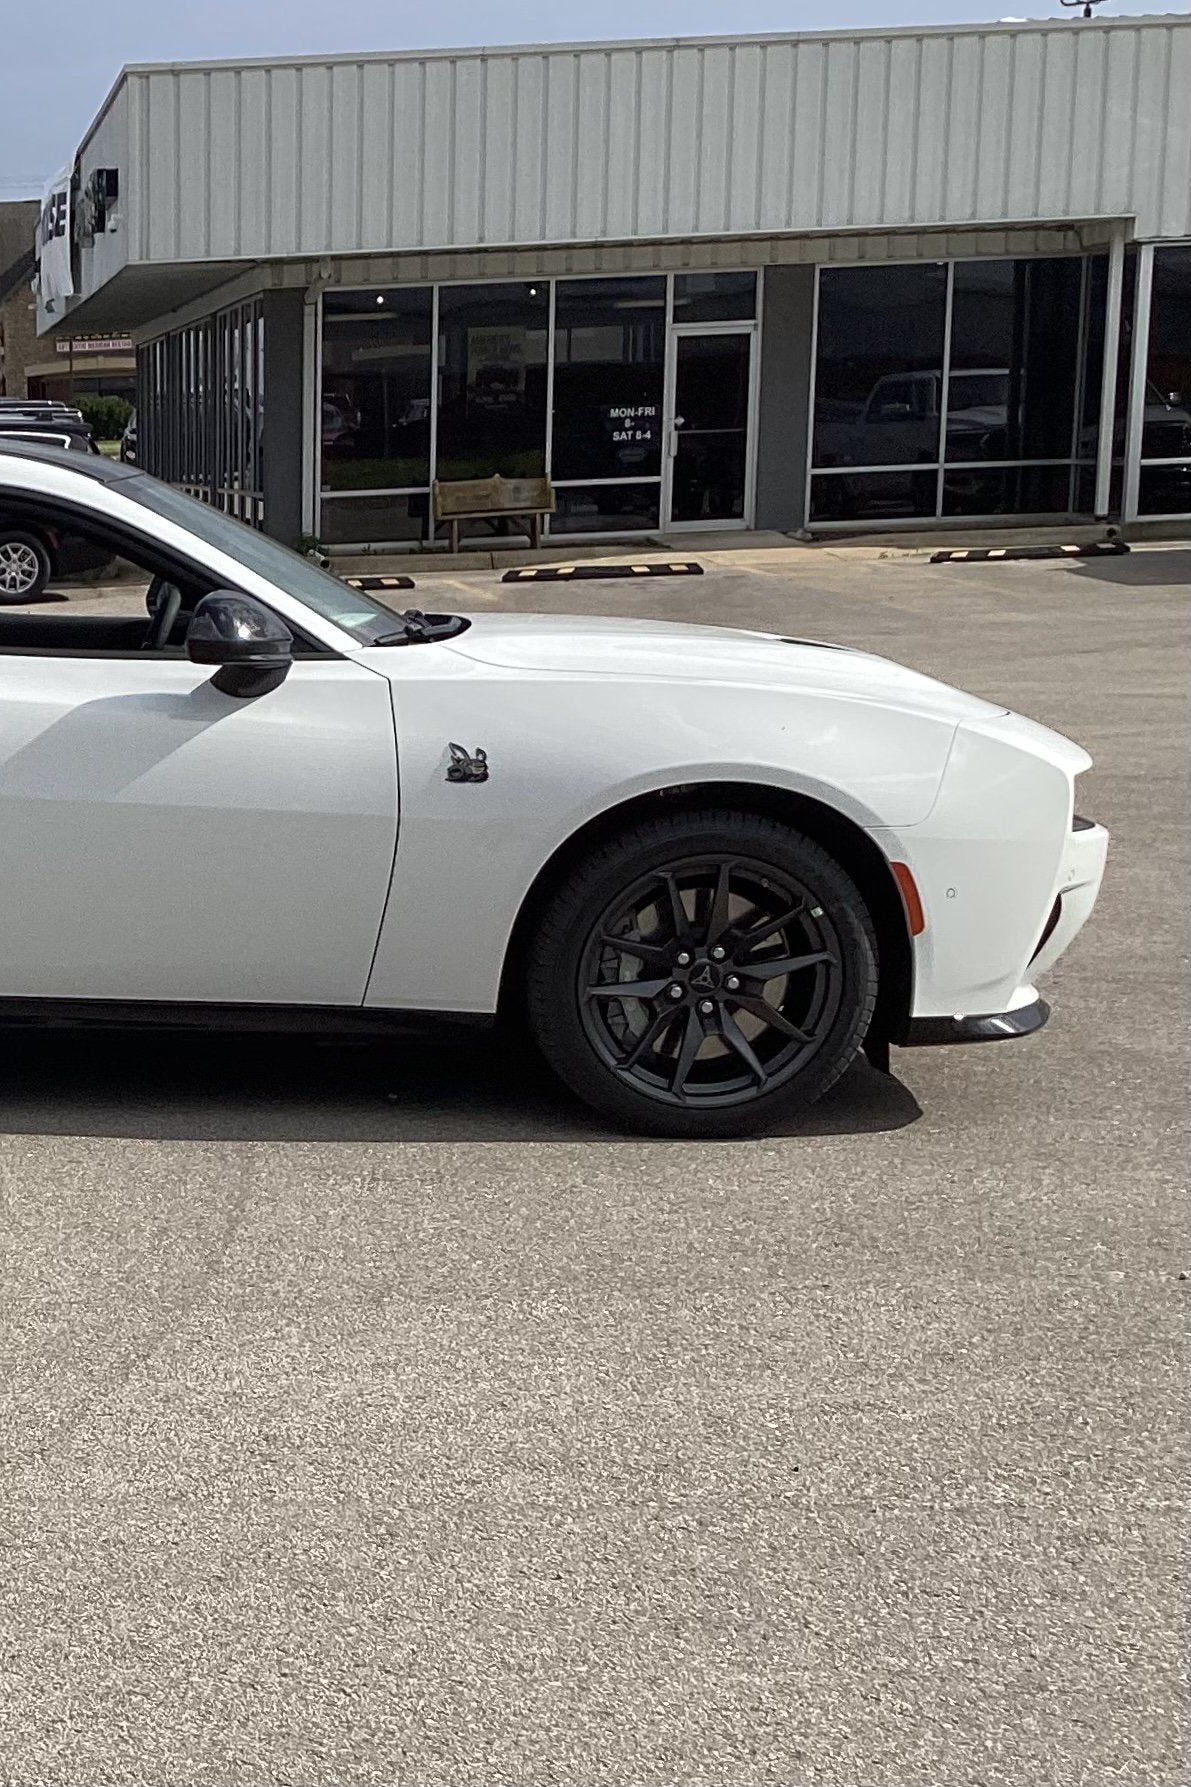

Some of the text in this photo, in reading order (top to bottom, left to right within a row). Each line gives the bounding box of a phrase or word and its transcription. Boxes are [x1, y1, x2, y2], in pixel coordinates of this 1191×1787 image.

[610, 406, 655, 418] MON-FRI
[612, 430, 652, 441] SAT 8-4
